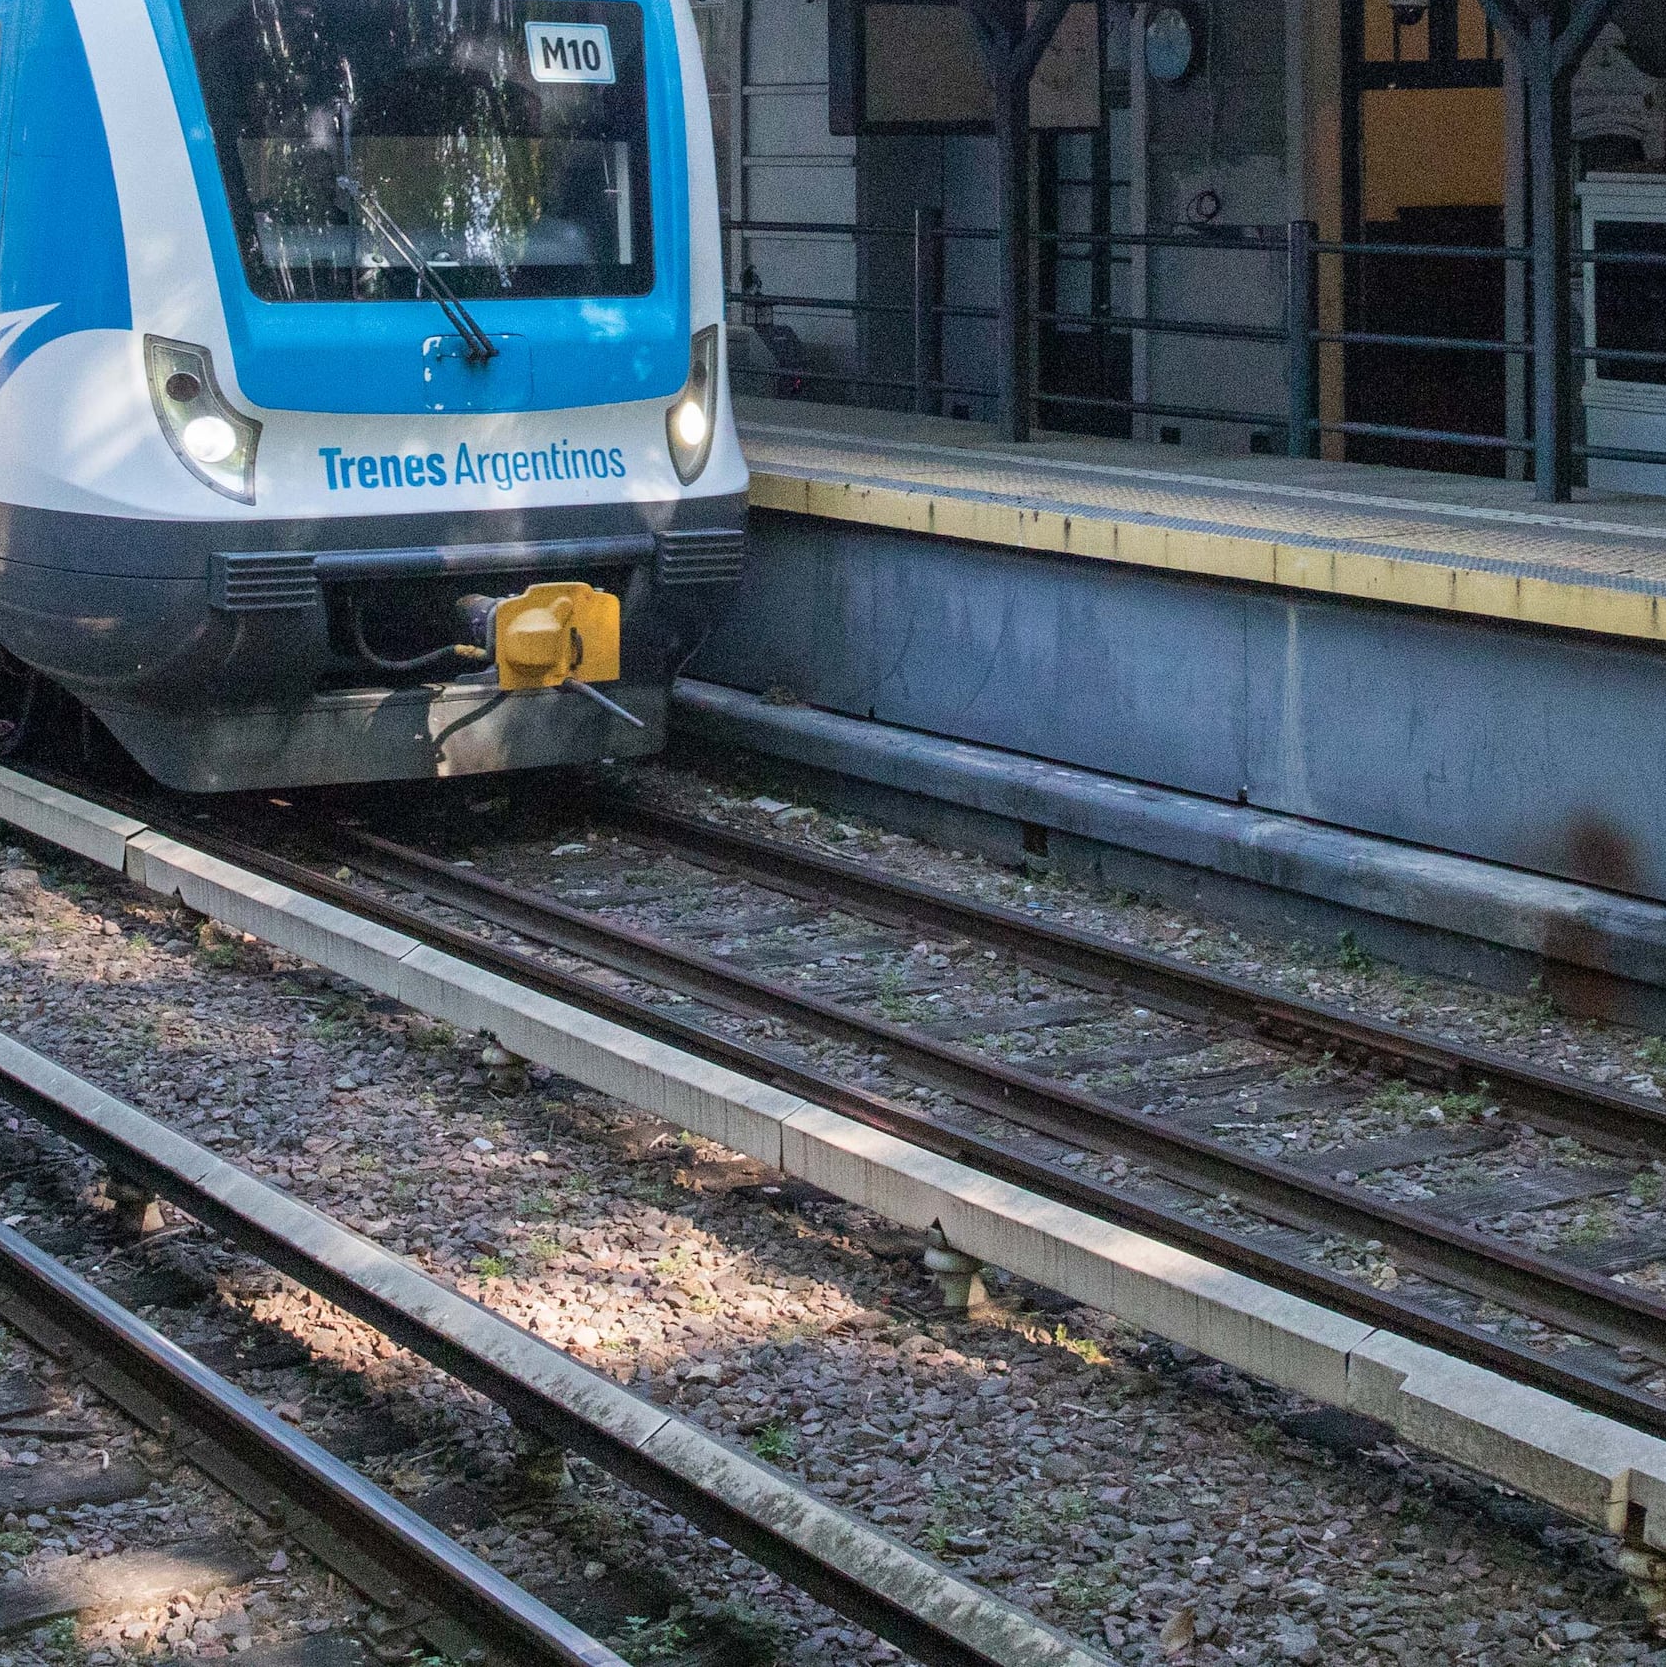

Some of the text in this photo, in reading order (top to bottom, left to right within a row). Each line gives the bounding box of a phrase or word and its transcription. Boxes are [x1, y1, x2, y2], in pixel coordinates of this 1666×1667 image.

[540, 36, 601, 71] M10
[318, 438, 627, 491] Trenes Argentinos
